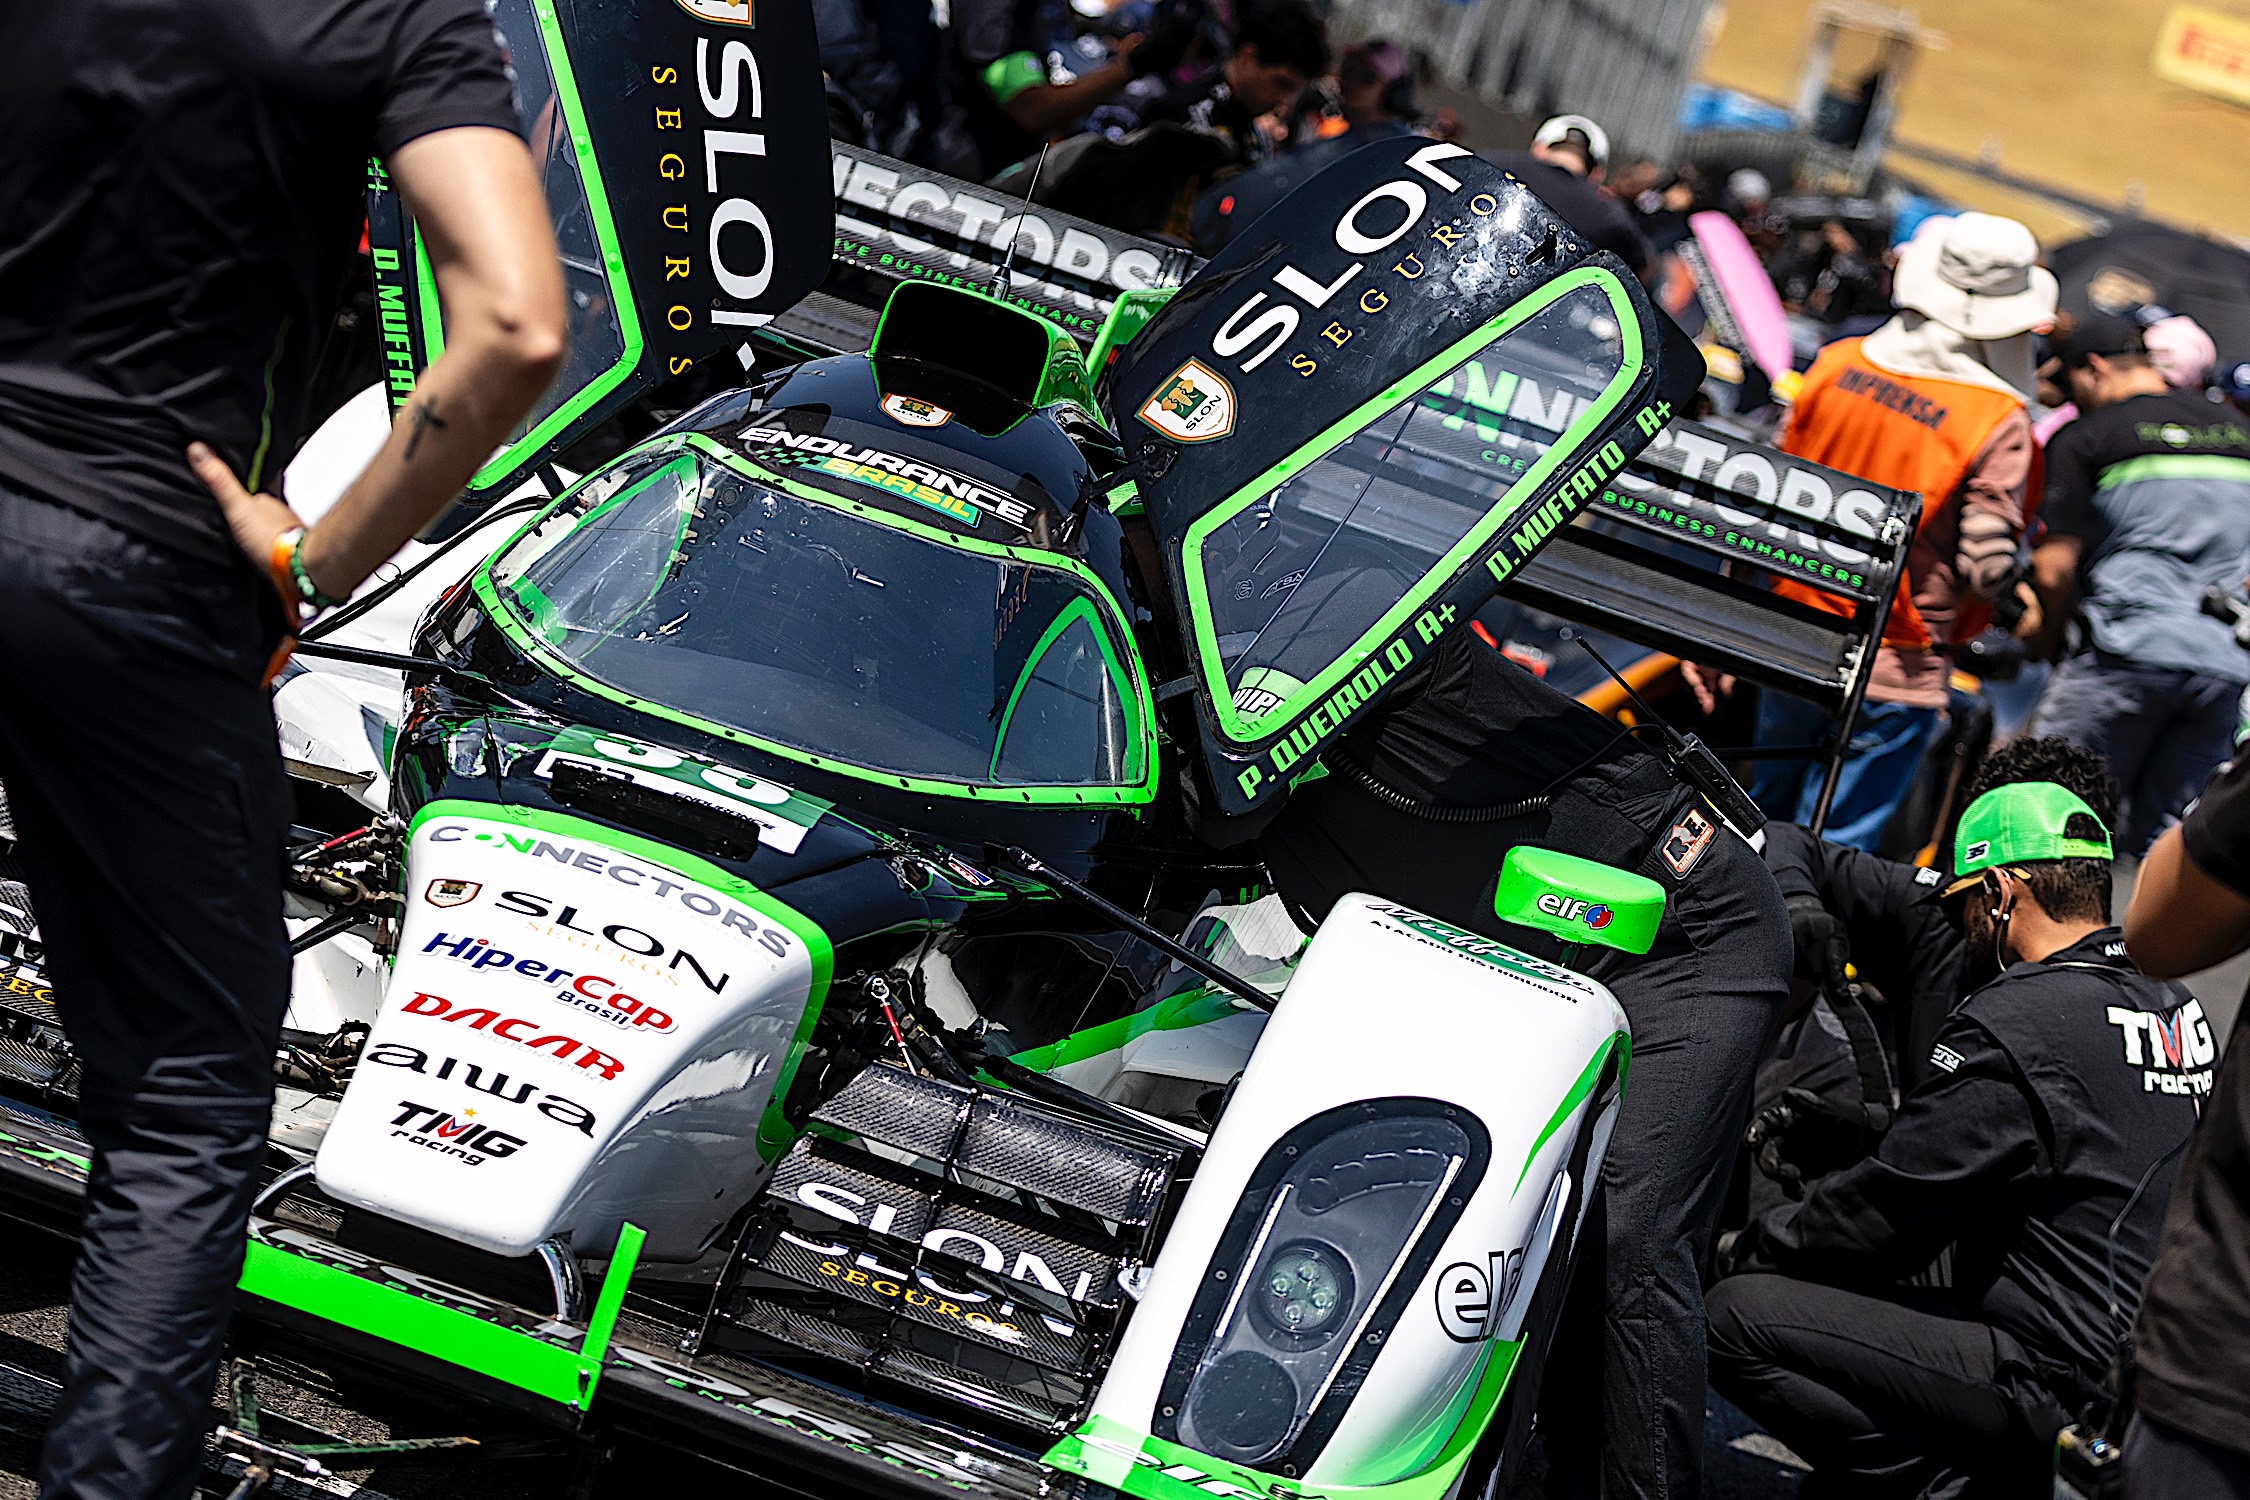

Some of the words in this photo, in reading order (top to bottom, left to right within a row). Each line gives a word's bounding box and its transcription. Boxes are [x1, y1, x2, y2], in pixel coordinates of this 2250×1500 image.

[651, 66, 693, 376] SEGUROS
[1291, 171, 1527, 380] SEGURO
[1186, 394, 1222, 431] SLON
[1636, 400, 1672, 438] A+
[737, 427, 1032, 524] ENDURANCE
[821, 457, 972, 518] BRASIL
[1415, 602, 1458, 648] A+
[1485, 440, 1627, 583] D.MUFFATO
[1602, 490, 1715, 538] BUSINESS
[1724, 530, 1864, 589] ENHANCERS
[428, 825, 793, 959] CONNECTORS
[1371, 920, 1452, 953] ATACADO
[1537, 893, 1586, 921] elf
[421, 932, 675, 1032] HiperCap
[494, 890, 730, 996] SLON
[525, 921, 680, 987] SEGUROS
[400, 991, 625, 1081] DACAR
[556, 990, 629, 1026] Brasil
[2107, 998, 2215, 1068] TMG
[367, 1042, 597, 1140] aiwa
[391, 1101, 529, 1160] TMG
[391, 1130, 486, 1167] racing
[779, 1181, 1093, 1339] SLON
